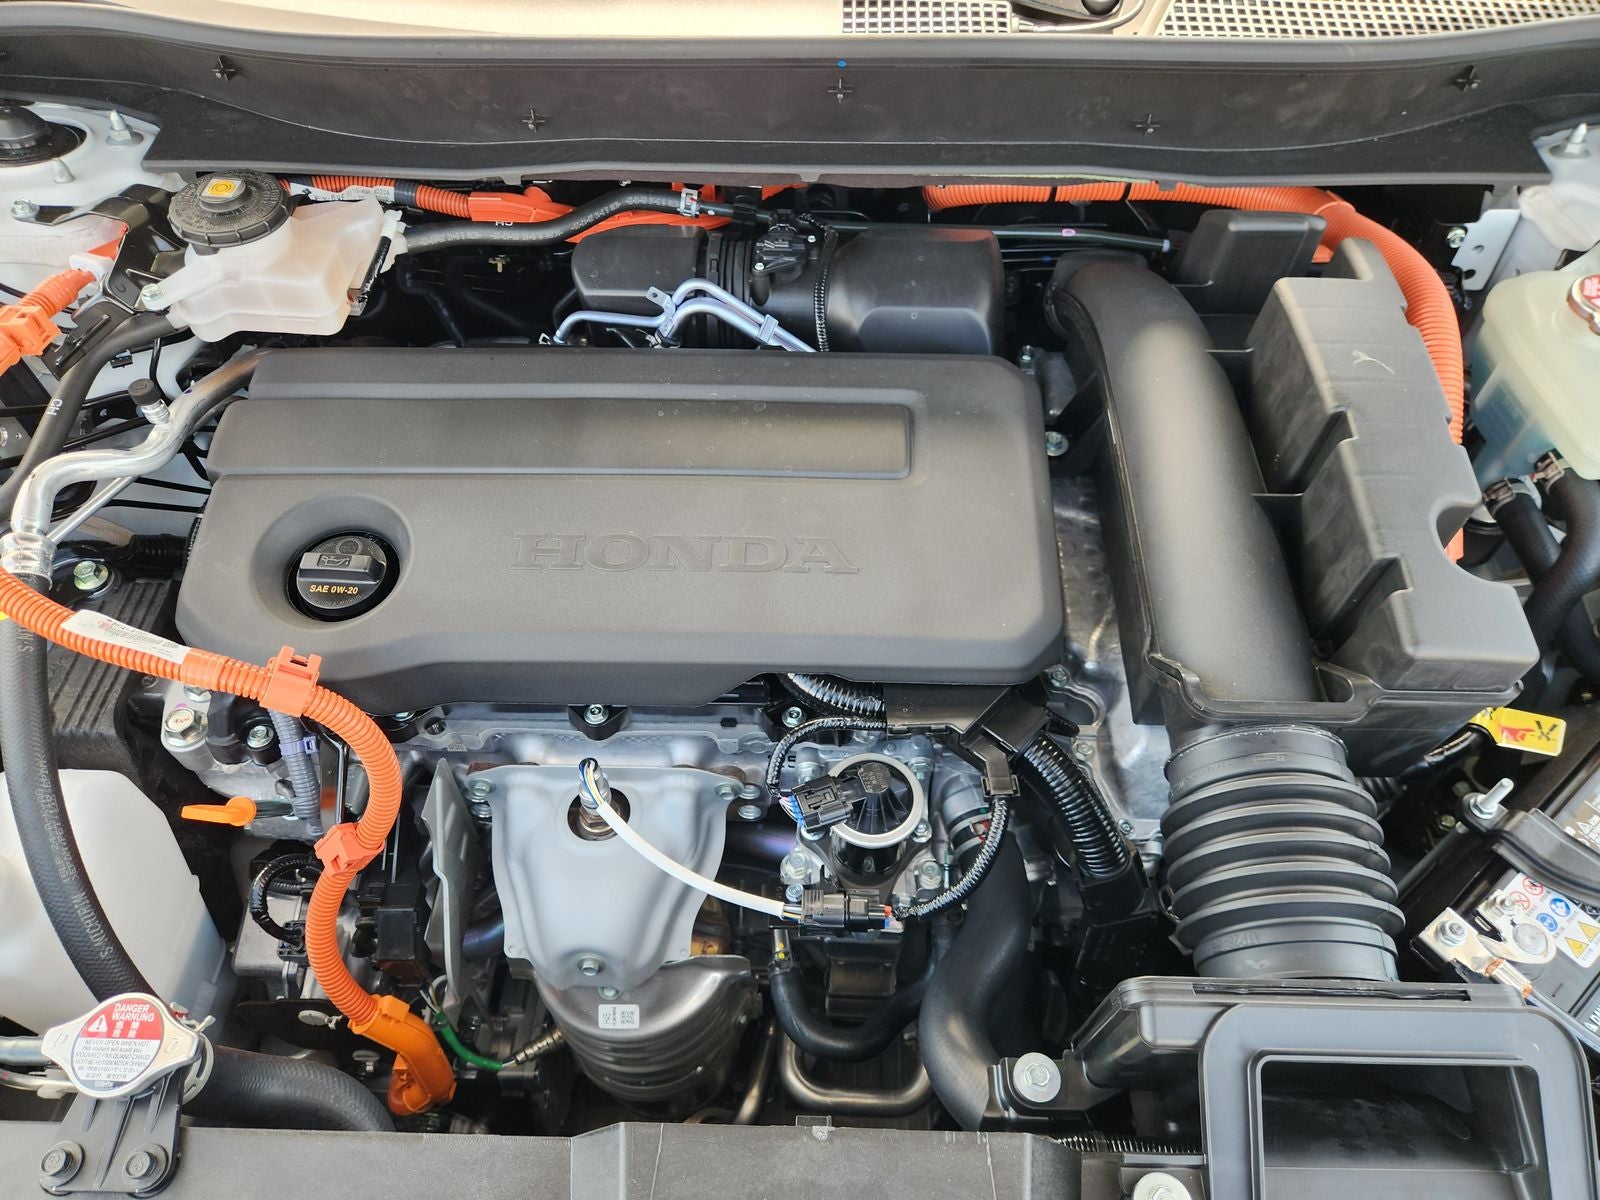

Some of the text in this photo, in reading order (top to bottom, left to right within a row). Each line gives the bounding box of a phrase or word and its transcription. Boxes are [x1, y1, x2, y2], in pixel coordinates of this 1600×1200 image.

[508, 533, 860, 574] HONDA
[309, 584, 358, 595] SAE 0W-20
[114, 1003, 150, 1013] DANGER
[111, 1012, 155, 1022] WARNUNG
